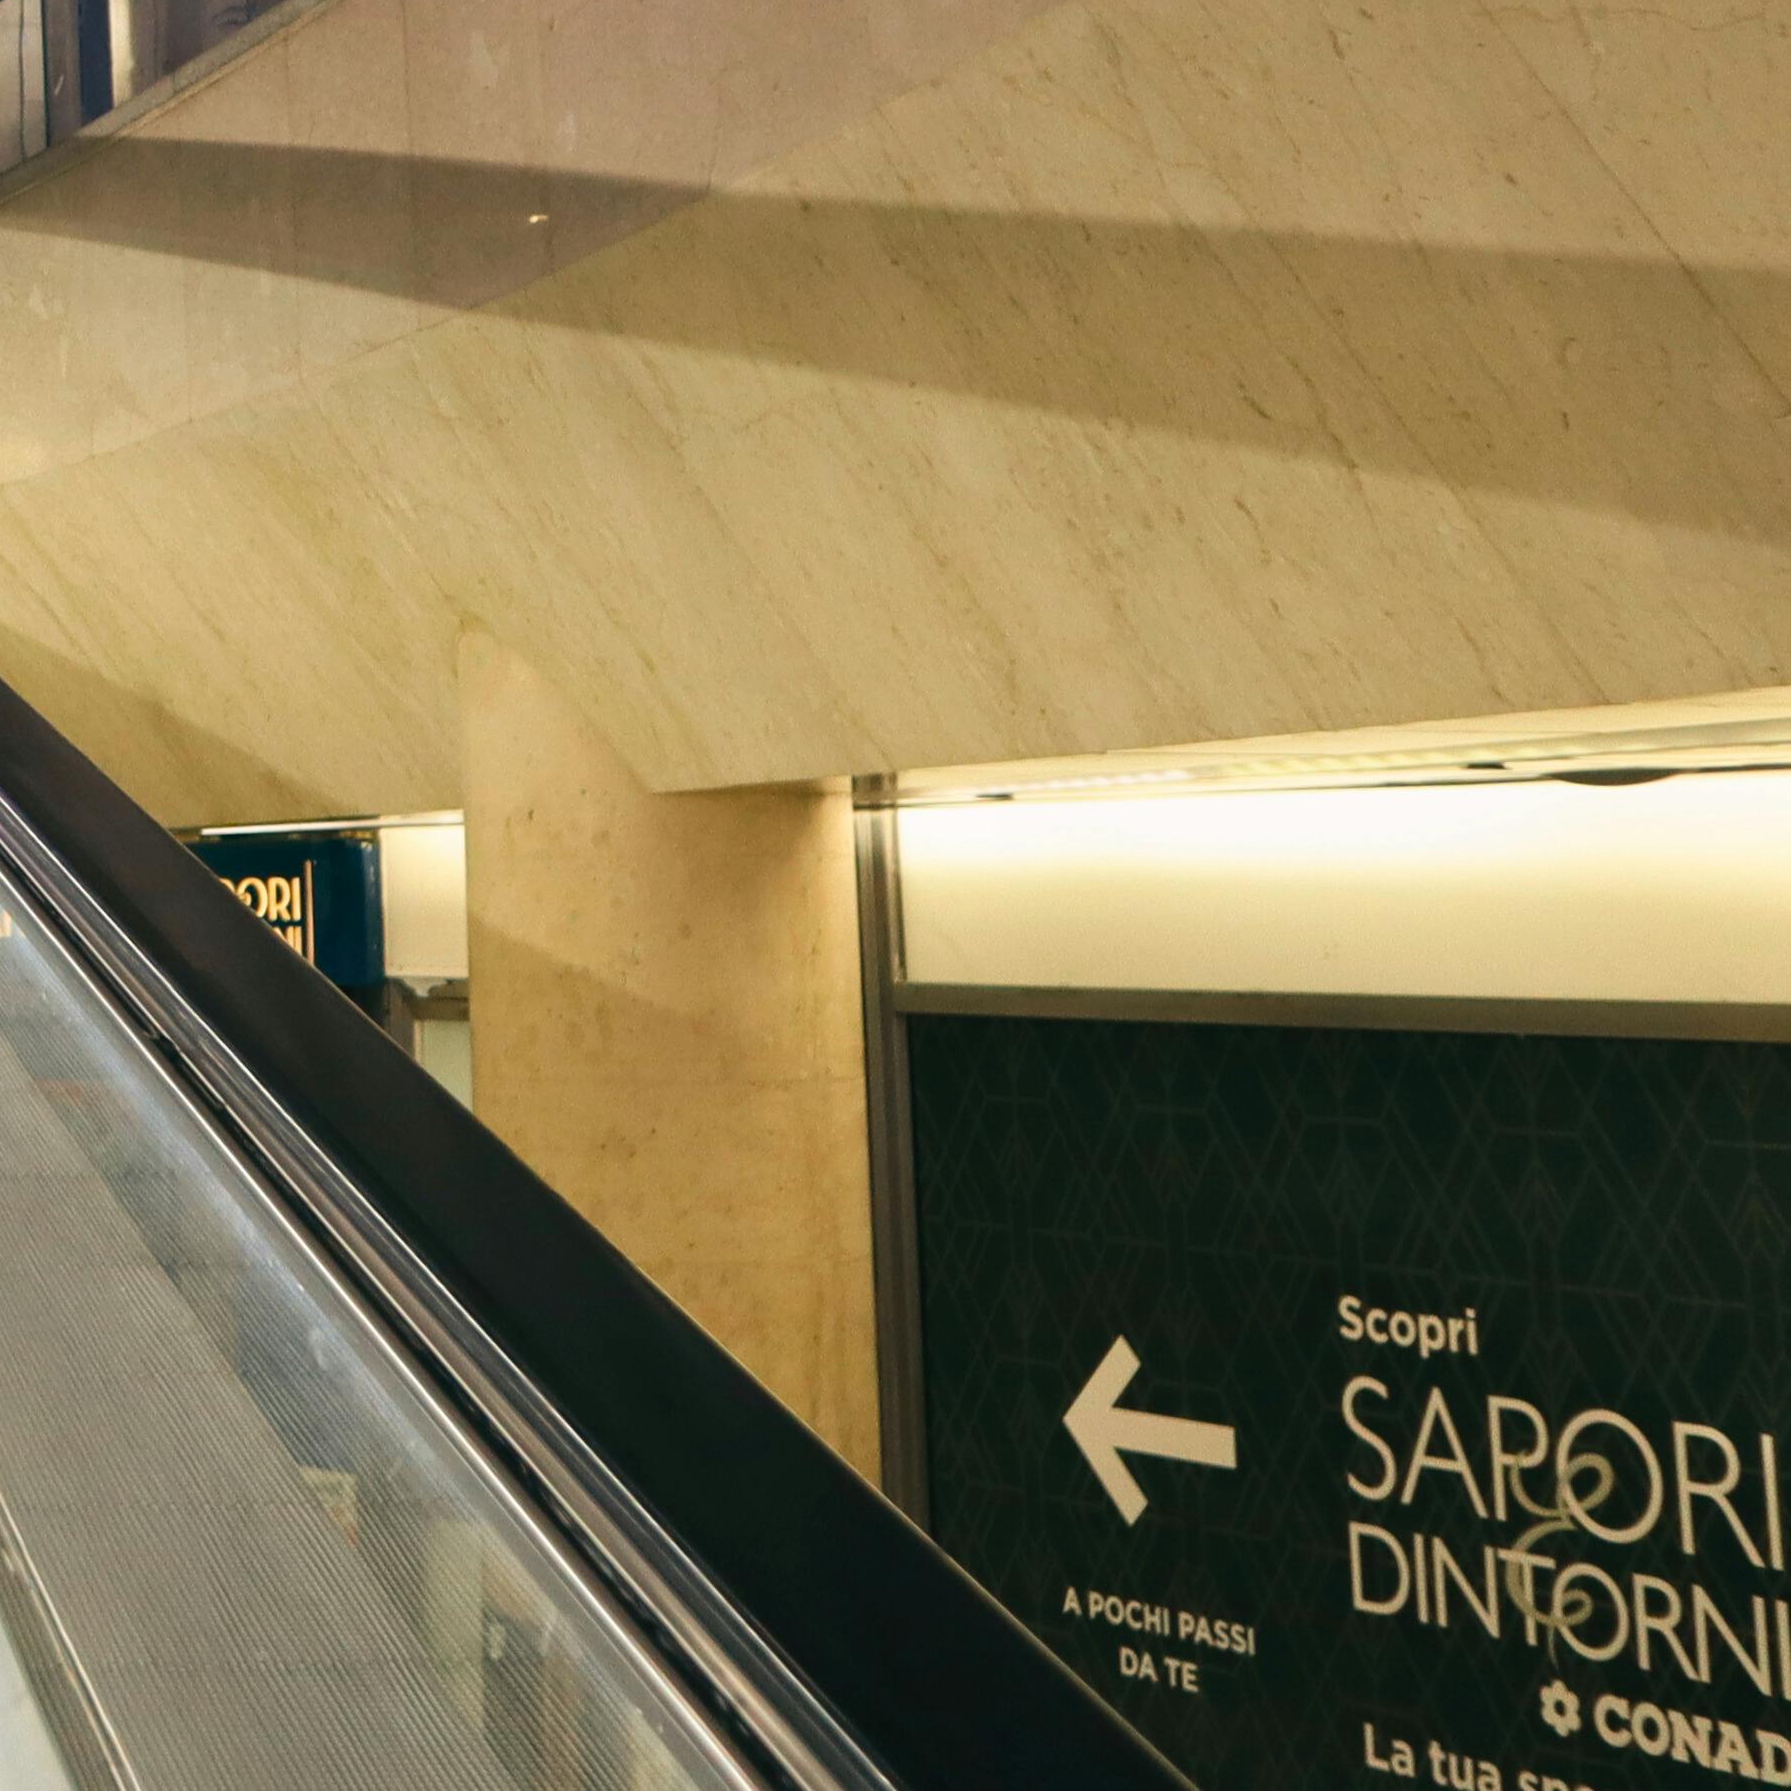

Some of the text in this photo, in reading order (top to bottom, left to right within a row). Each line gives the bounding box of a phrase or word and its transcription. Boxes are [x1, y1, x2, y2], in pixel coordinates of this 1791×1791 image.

[1338, 1294, 1479, 1359] Scopri
[1342, 1375, 1786, 1571] SAPORI
[1062, 1585, 1256, 1656] A POCHI PASSI
[1348, 1520, 1791, 1702] DINTORNI
[1120, 1645, 1200, 1694] DA TE
[1362, 1721, 1503, 1791] La tua
[1593, 1693, 1791, 1788] CONAD
